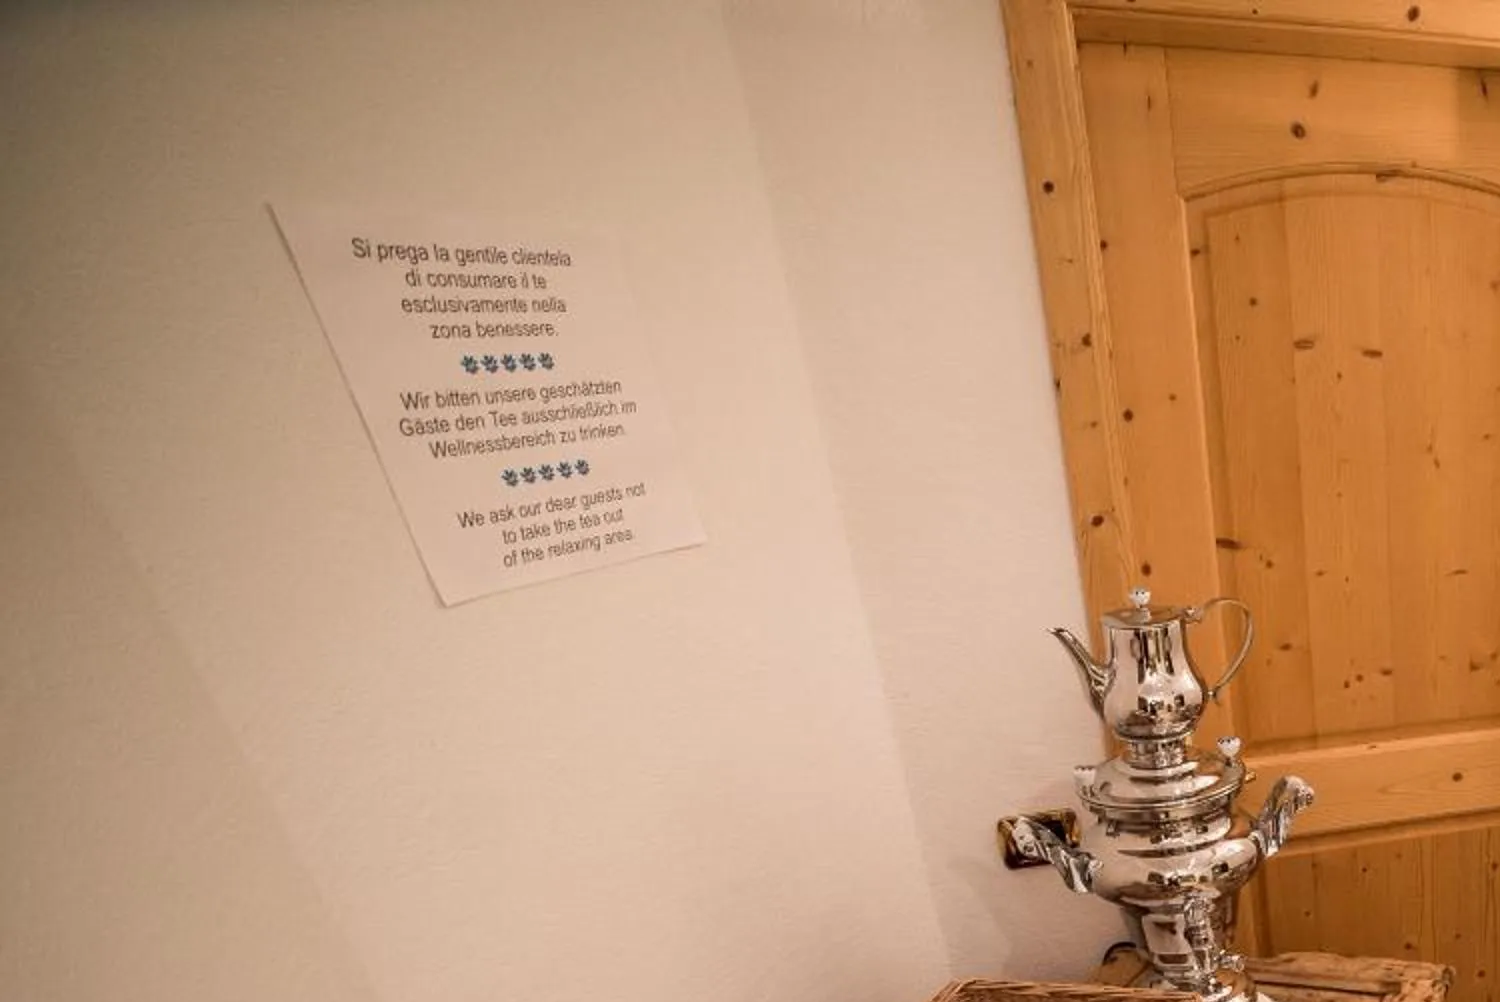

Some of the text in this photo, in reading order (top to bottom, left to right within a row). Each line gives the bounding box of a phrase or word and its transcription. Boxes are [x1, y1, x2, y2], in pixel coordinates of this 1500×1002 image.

[352, 237, 571, 267] Si prega la gentile clientela
[405, 268, 421, 287] di
[427, 273, 517, 288] consumare
[521, 272, 529, 288] il
[401, 295, 567, 313] esclusivamente nella
[430, 320, 559, 338] zona benessere.
[400, 391, 430, 410] Wir
[435, 388, 481, 408] bitten
[485, 387, 536, 405] unsere
[455, 414, 485, 431] den
[488, 410, 517, 427] Tee
[620, 400, 637, 414] im
[428, 429, 556, 458] Wellnessbereich
[559, 430, 577, 443] zu
[456, 482, 646, 528] We ask our dear guests not
[502, 508, 624, 545] to take the tea out
[503, 550, 518, 568] of
[521, 545, 545, 563] the
[547, 533, 602, 558] relaxing
